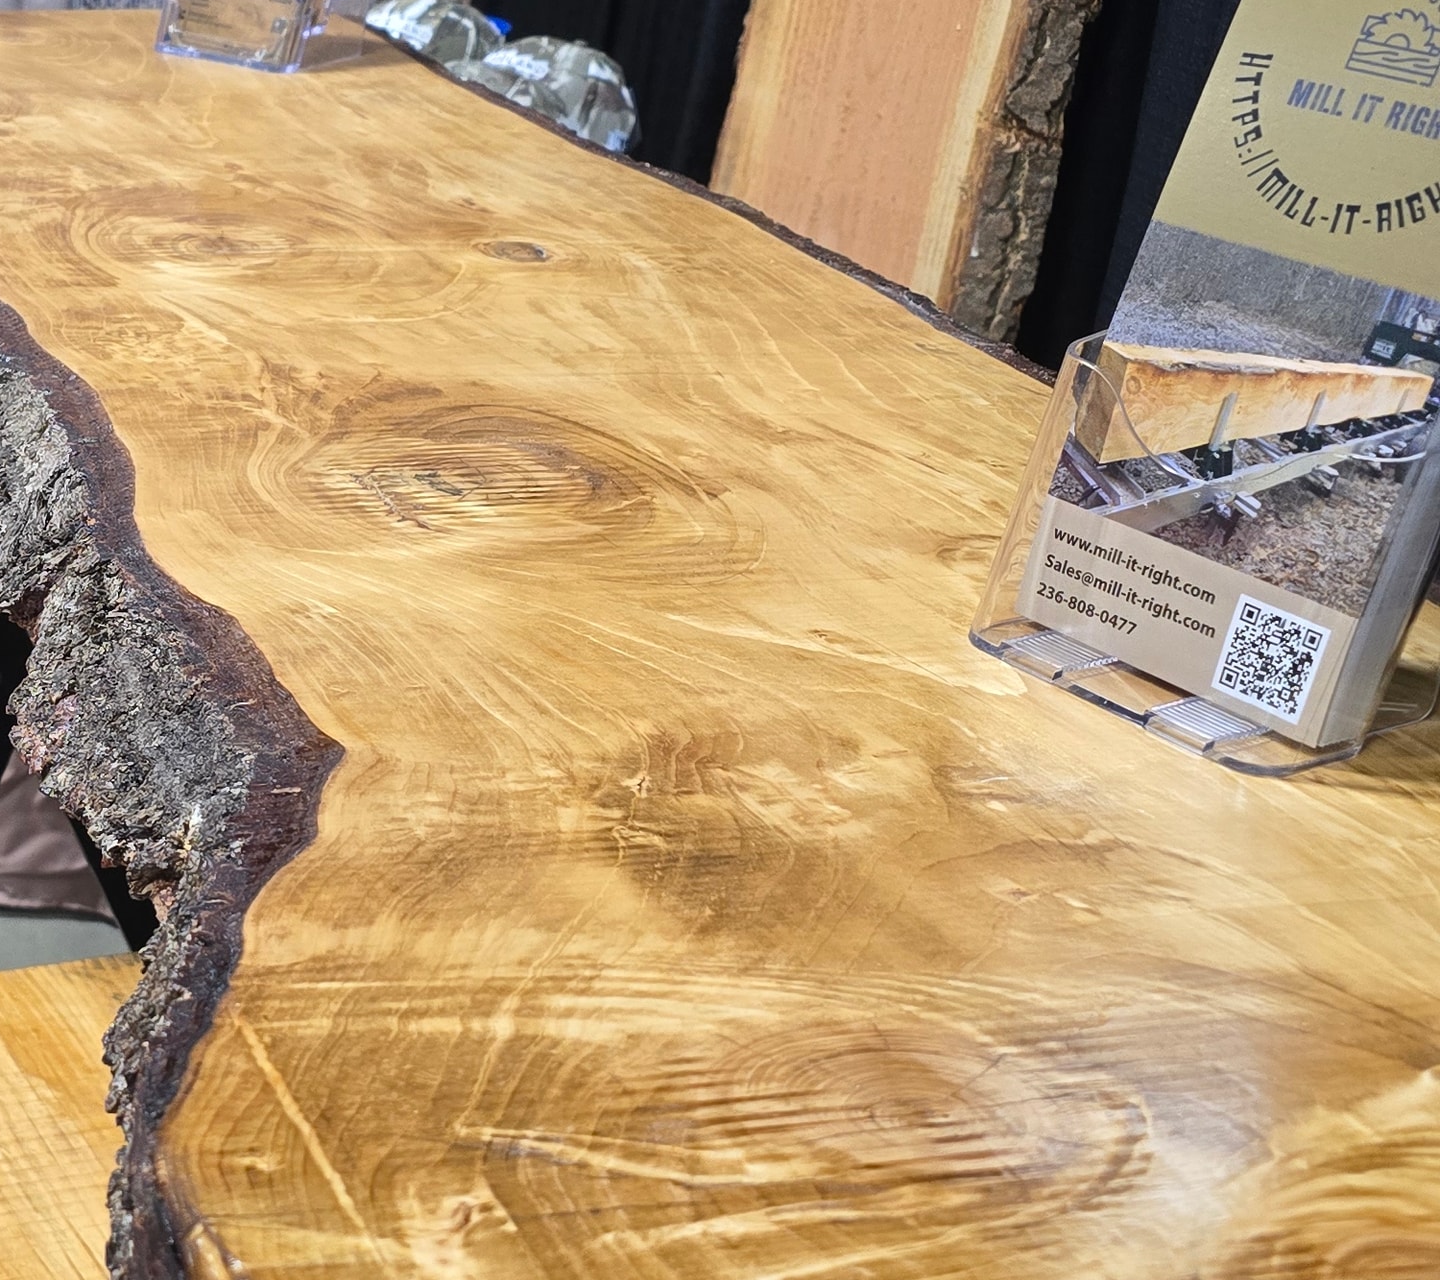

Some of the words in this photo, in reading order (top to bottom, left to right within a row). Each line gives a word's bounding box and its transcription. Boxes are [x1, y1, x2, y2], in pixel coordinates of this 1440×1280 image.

[1287, 79, 1346, 117] MILL
[1352, 93, 1384, 123] IT
[1044, 554, 1216, 638] Sales@mill-it-right.com
[1054, 528, 1216, 605] www.mill-it-right.com
[1037, 582, 1137, 635] 236-808-0477
